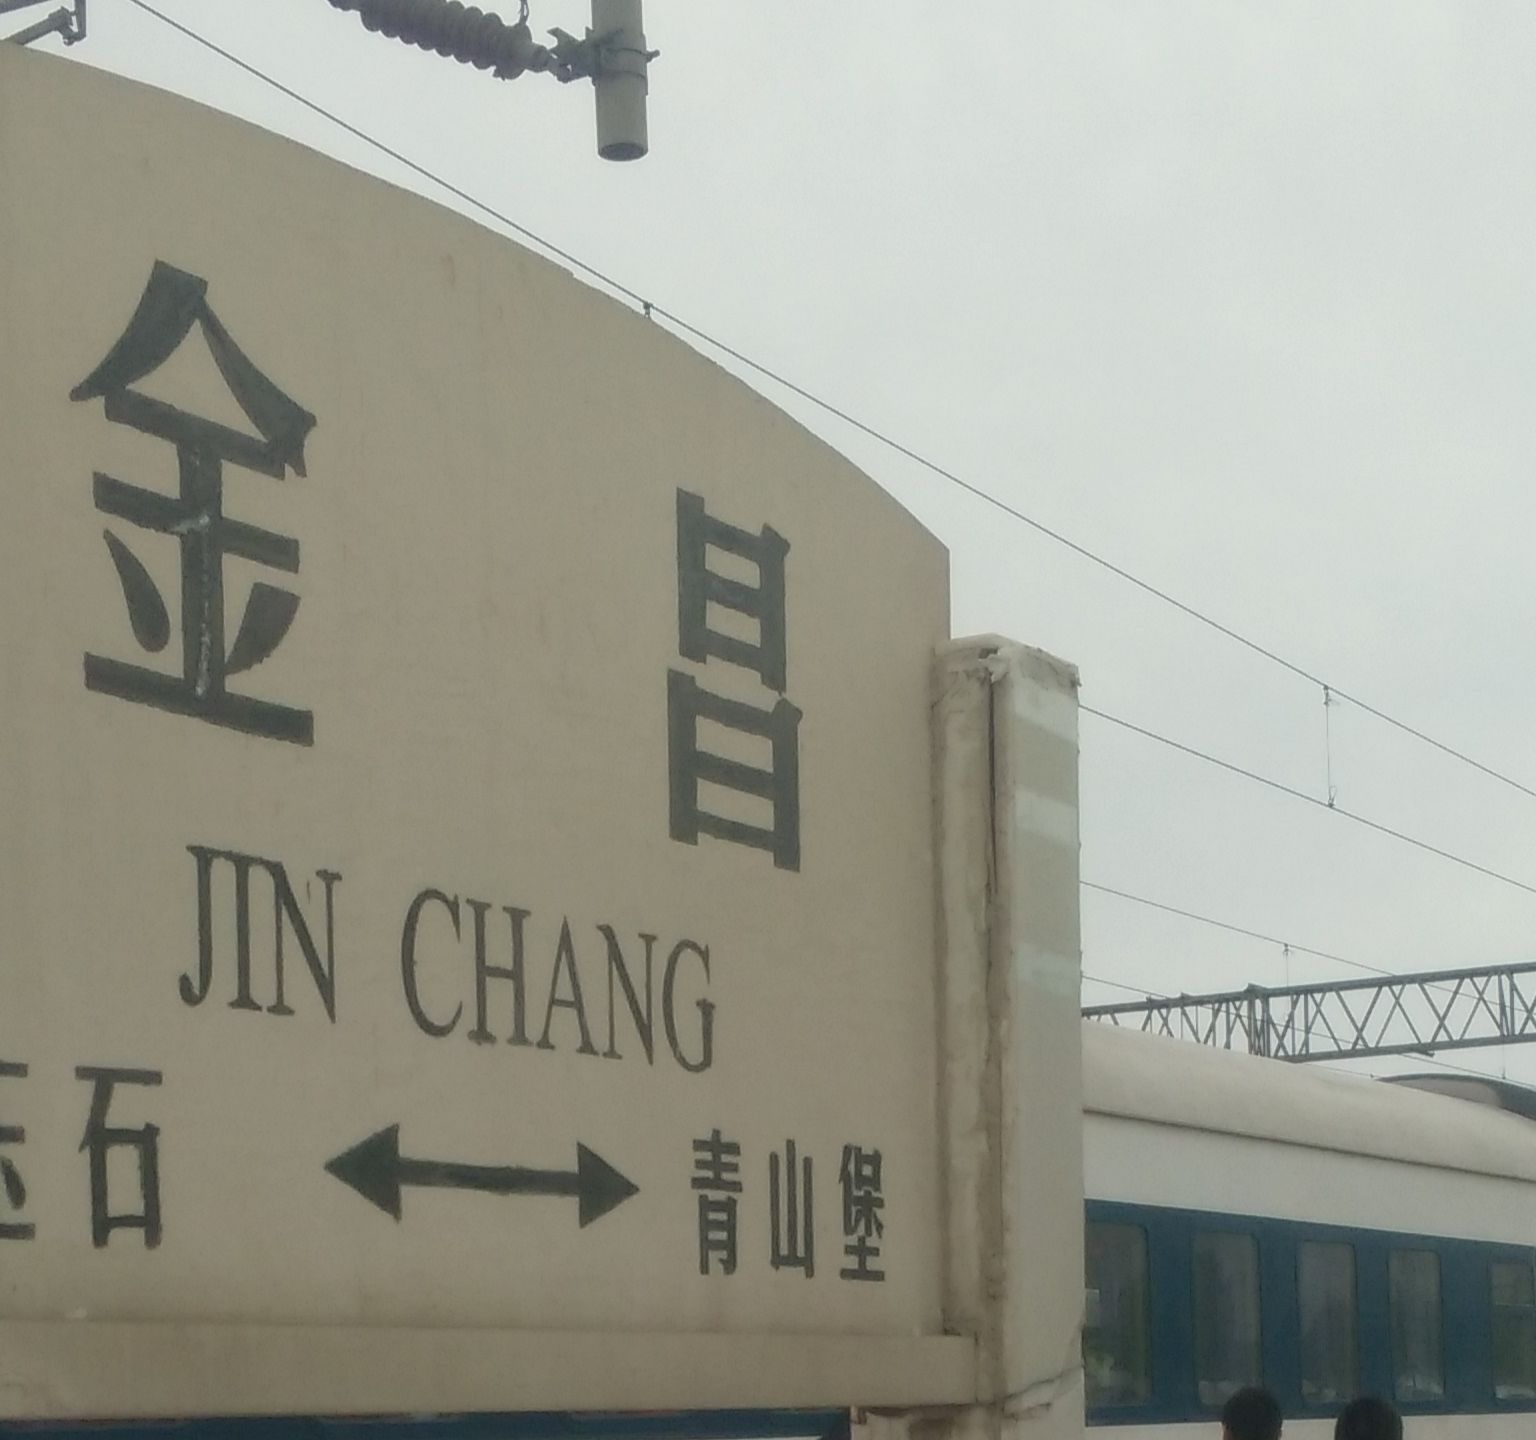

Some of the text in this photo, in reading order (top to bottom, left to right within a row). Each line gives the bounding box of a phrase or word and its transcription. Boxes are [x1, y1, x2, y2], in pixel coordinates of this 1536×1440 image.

[71, 260, 804, 874] 金昌
[179, 844, 717, 1074] JIN CHANG
[690, 1128, 886, 1283] 青山堡
